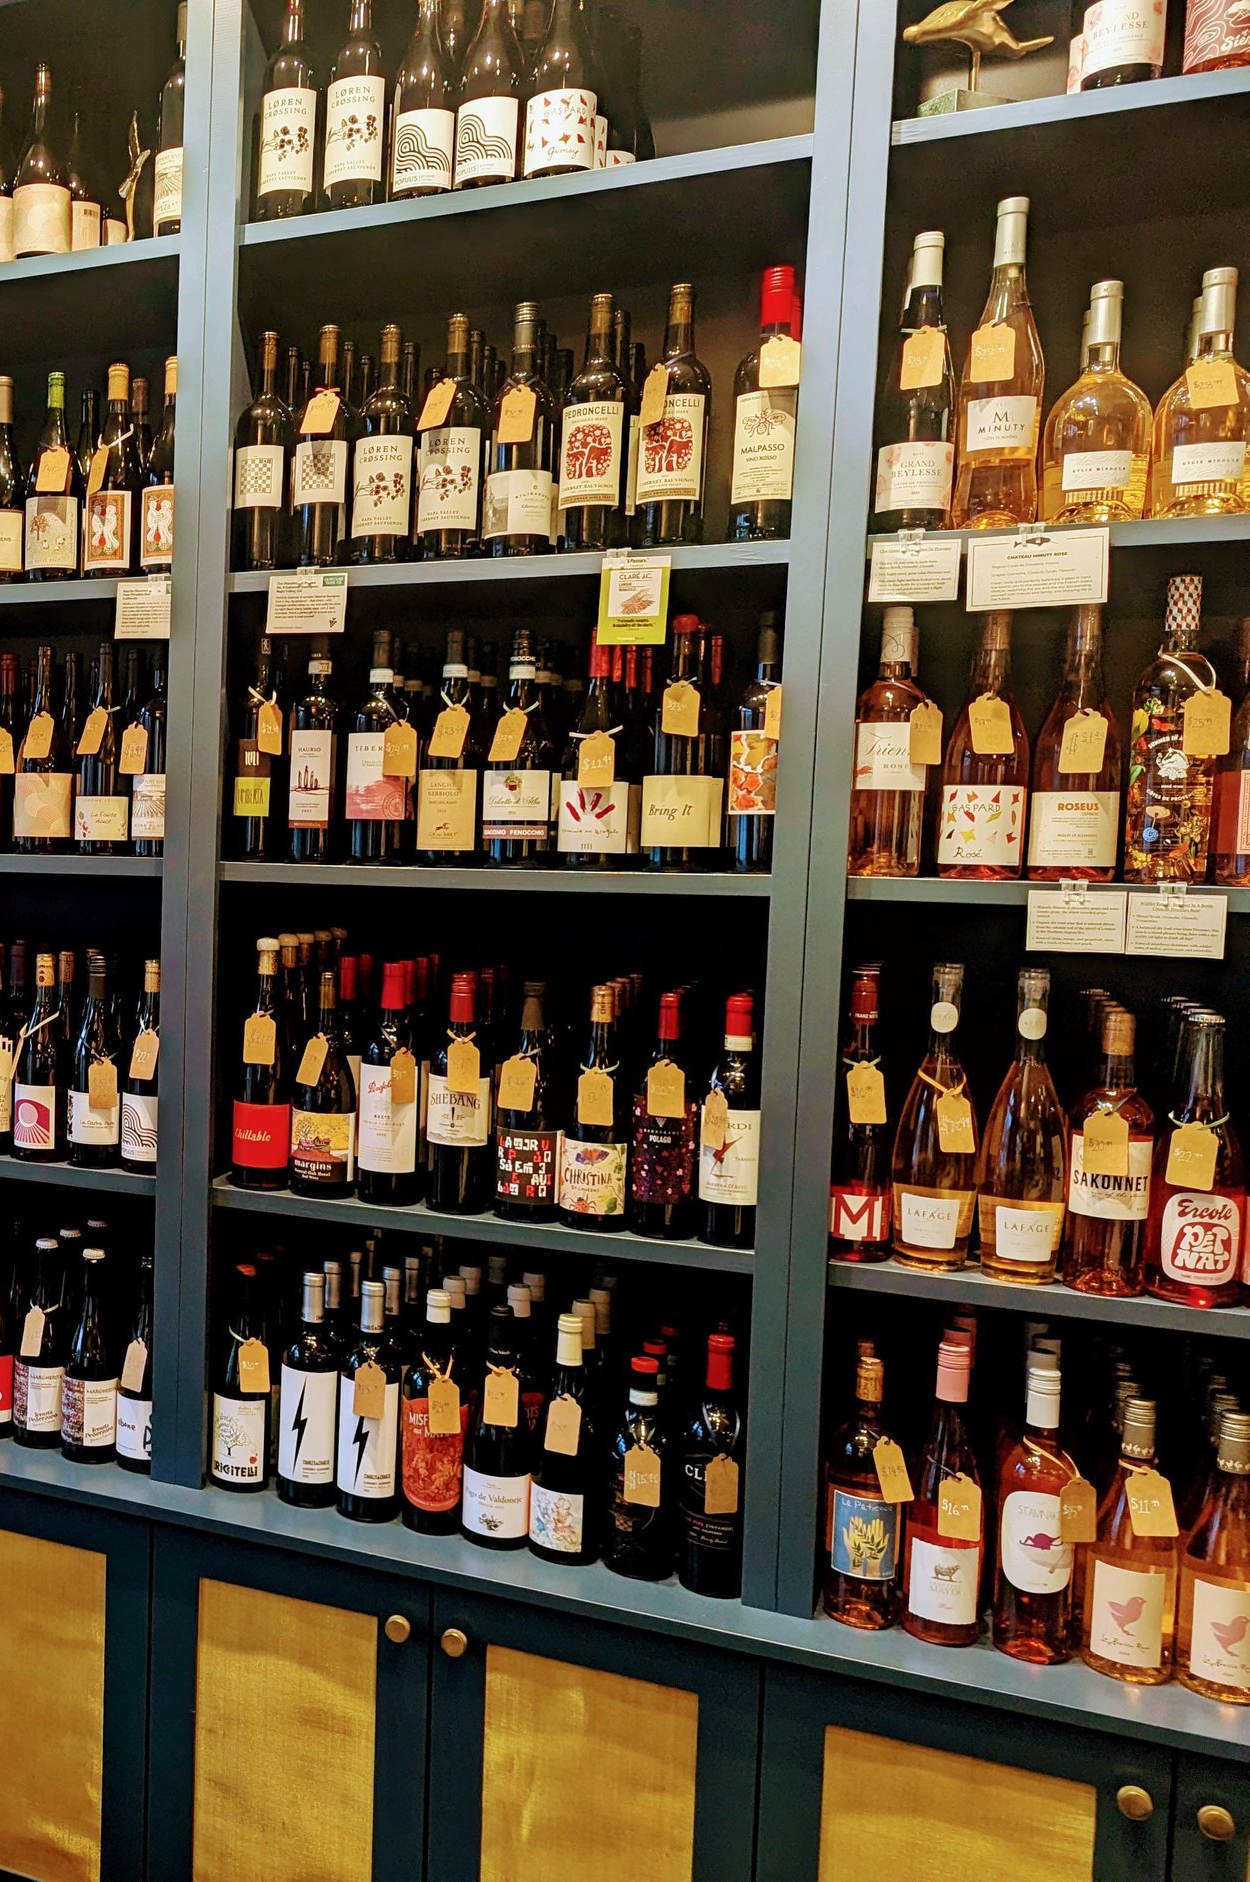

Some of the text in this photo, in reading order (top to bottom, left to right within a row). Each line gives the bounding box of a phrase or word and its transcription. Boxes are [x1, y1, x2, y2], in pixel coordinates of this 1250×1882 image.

[664, 399, 700, 409] ONCELLI
[564, 406, 619, 421] PEDRONCELLI
[978, 424, 1025, 434] MINUTY
[740, 443, 785, 455] MALPASSO
[900, 459, 935, 469] GRAND
[891, 468, 943, 478] BEYLESSE
[649, 804, 693, 820] Bring It
[952, 803, 1001, 813] GASPARD
[1057, 802, 1099, 812] ROSEUS
[953, 846, 983, 859] Rosé
[431, 1093, 481, 1110] SHEBANG
[649, 1135, 672, 1144] POLAGO
[294, 1159, 332, 1171] margins
[564, 1167, 612, 1186] CHRISTINA
[1073, 1169, 1148, 1192] SAKONNET
[908, 1207, 952, 1222] LAFAGE
[1177, 1199, 1233, 1221] Ercole
[1004, 1219, 1050, 1234] LAFAGE
[1180, 1225, 1230, 1253] PÉT
[1174, 1249, 1229, 1270] NAT
[410, 1412, 428, 1426] MISF
[213, 1460, 258, 1477] RICCITELLI
[478, 1493, 487, 1501] de
